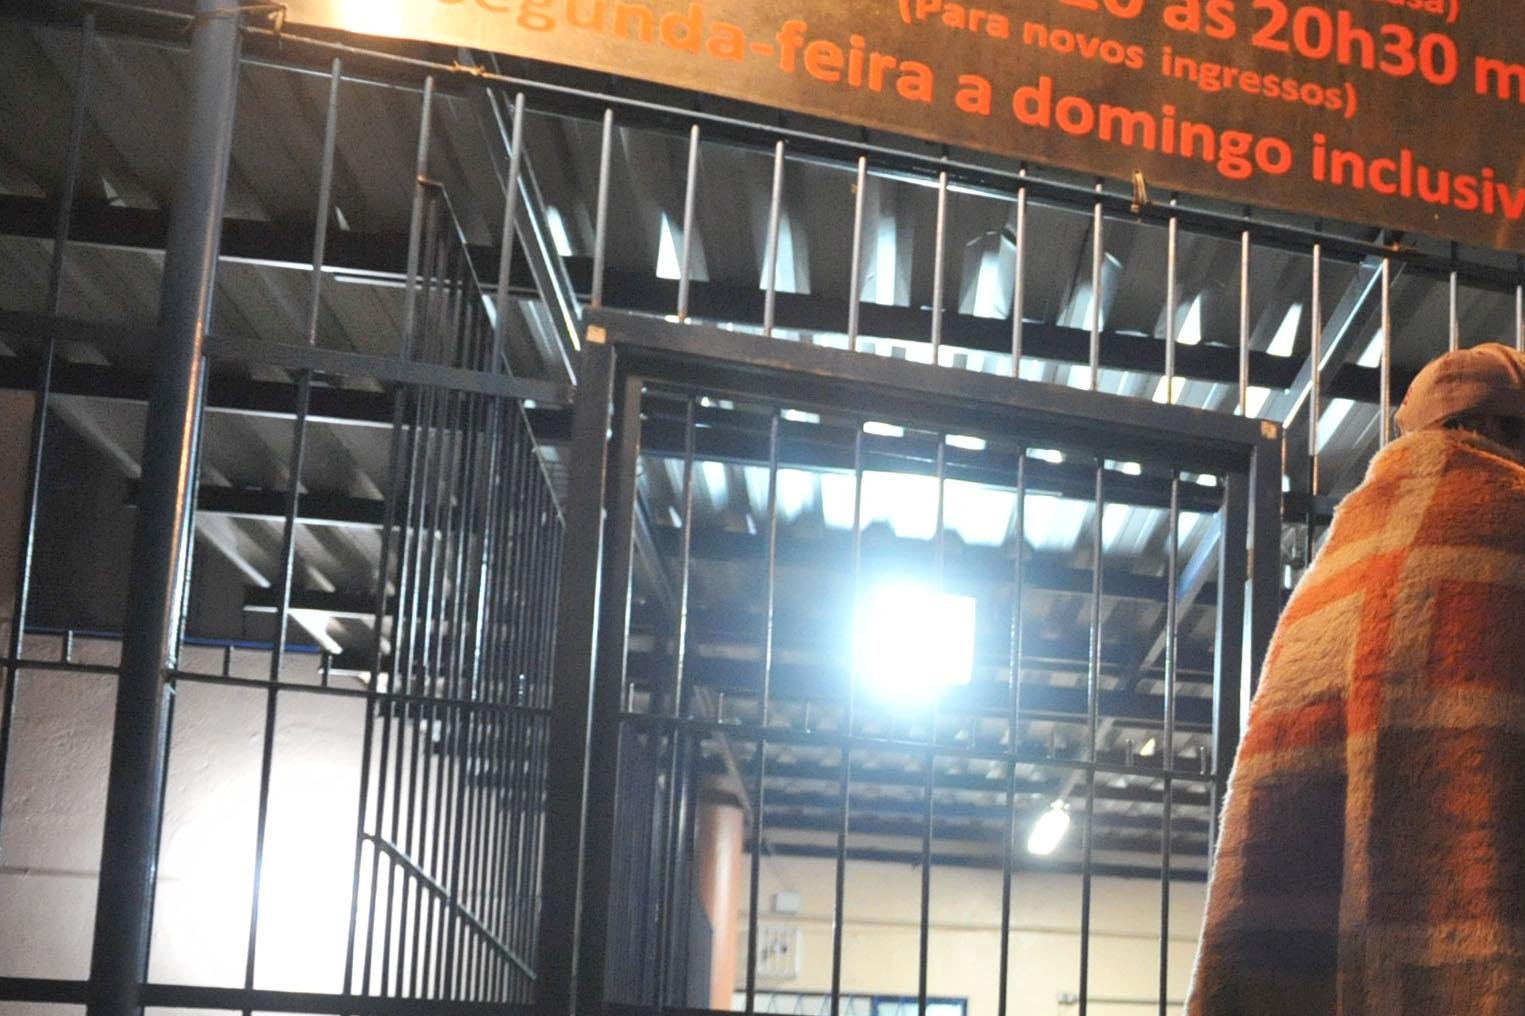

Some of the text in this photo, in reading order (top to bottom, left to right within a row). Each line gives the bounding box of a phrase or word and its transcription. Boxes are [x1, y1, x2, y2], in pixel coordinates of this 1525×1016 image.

[438, 0, 934, 105] gunda-feira
[955, 73, 992, 116] a
[1012, 76, 1292, 179] domingo
[898, 0, 1357, 118] (Para novos ingressos)
[1251, 0, 1458, 86] 20h30
